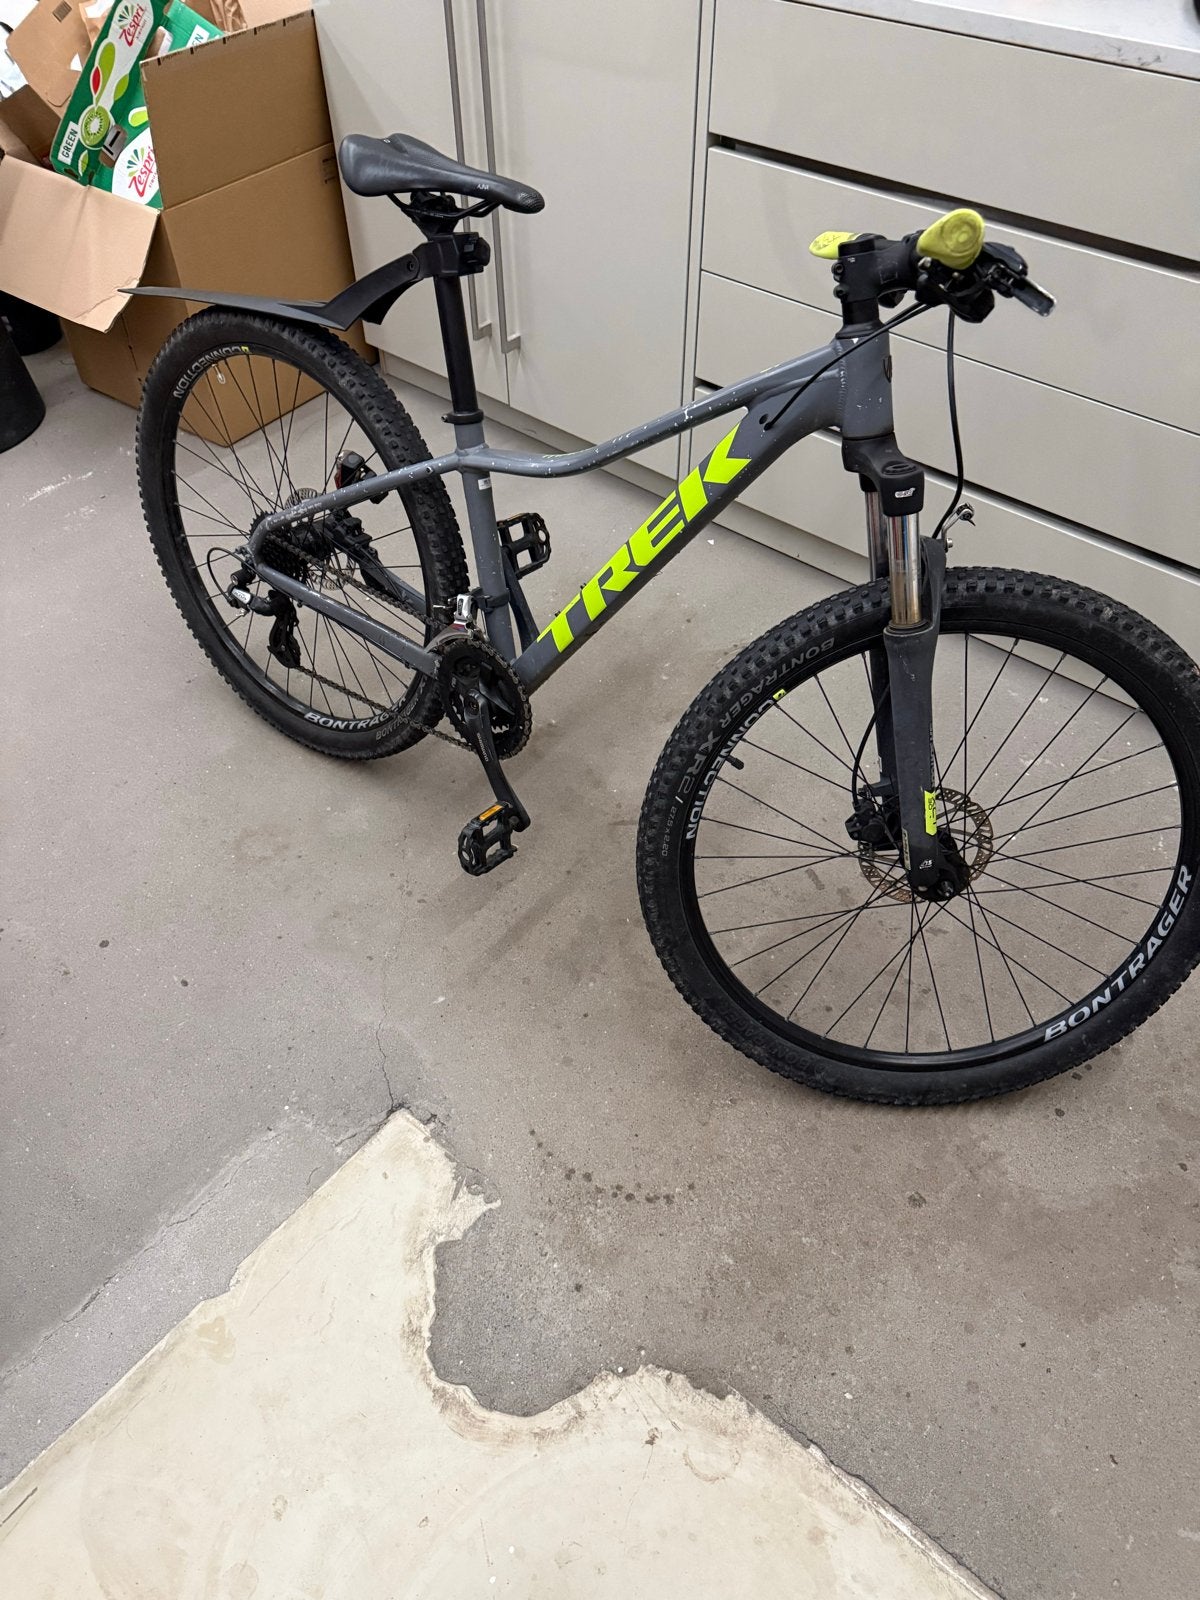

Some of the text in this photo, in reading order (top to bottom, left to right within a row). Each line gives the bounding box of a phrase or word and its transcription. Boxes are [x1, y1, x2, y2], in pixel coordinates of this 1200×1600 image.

[118, 4, 146, 47] Zespri
[62, 128, 78, 159] GREEN
[172, 345, 242, 399] CONNECTION
[536, 422, 752, 653] TREK
[719, 636, 836, 730] BONTRAGER
[677, 730, 721, 794] XR2
[684, 699, 775, 841] CONNECTION
[1043, 865, 1192, 1042] BONTRAGER
